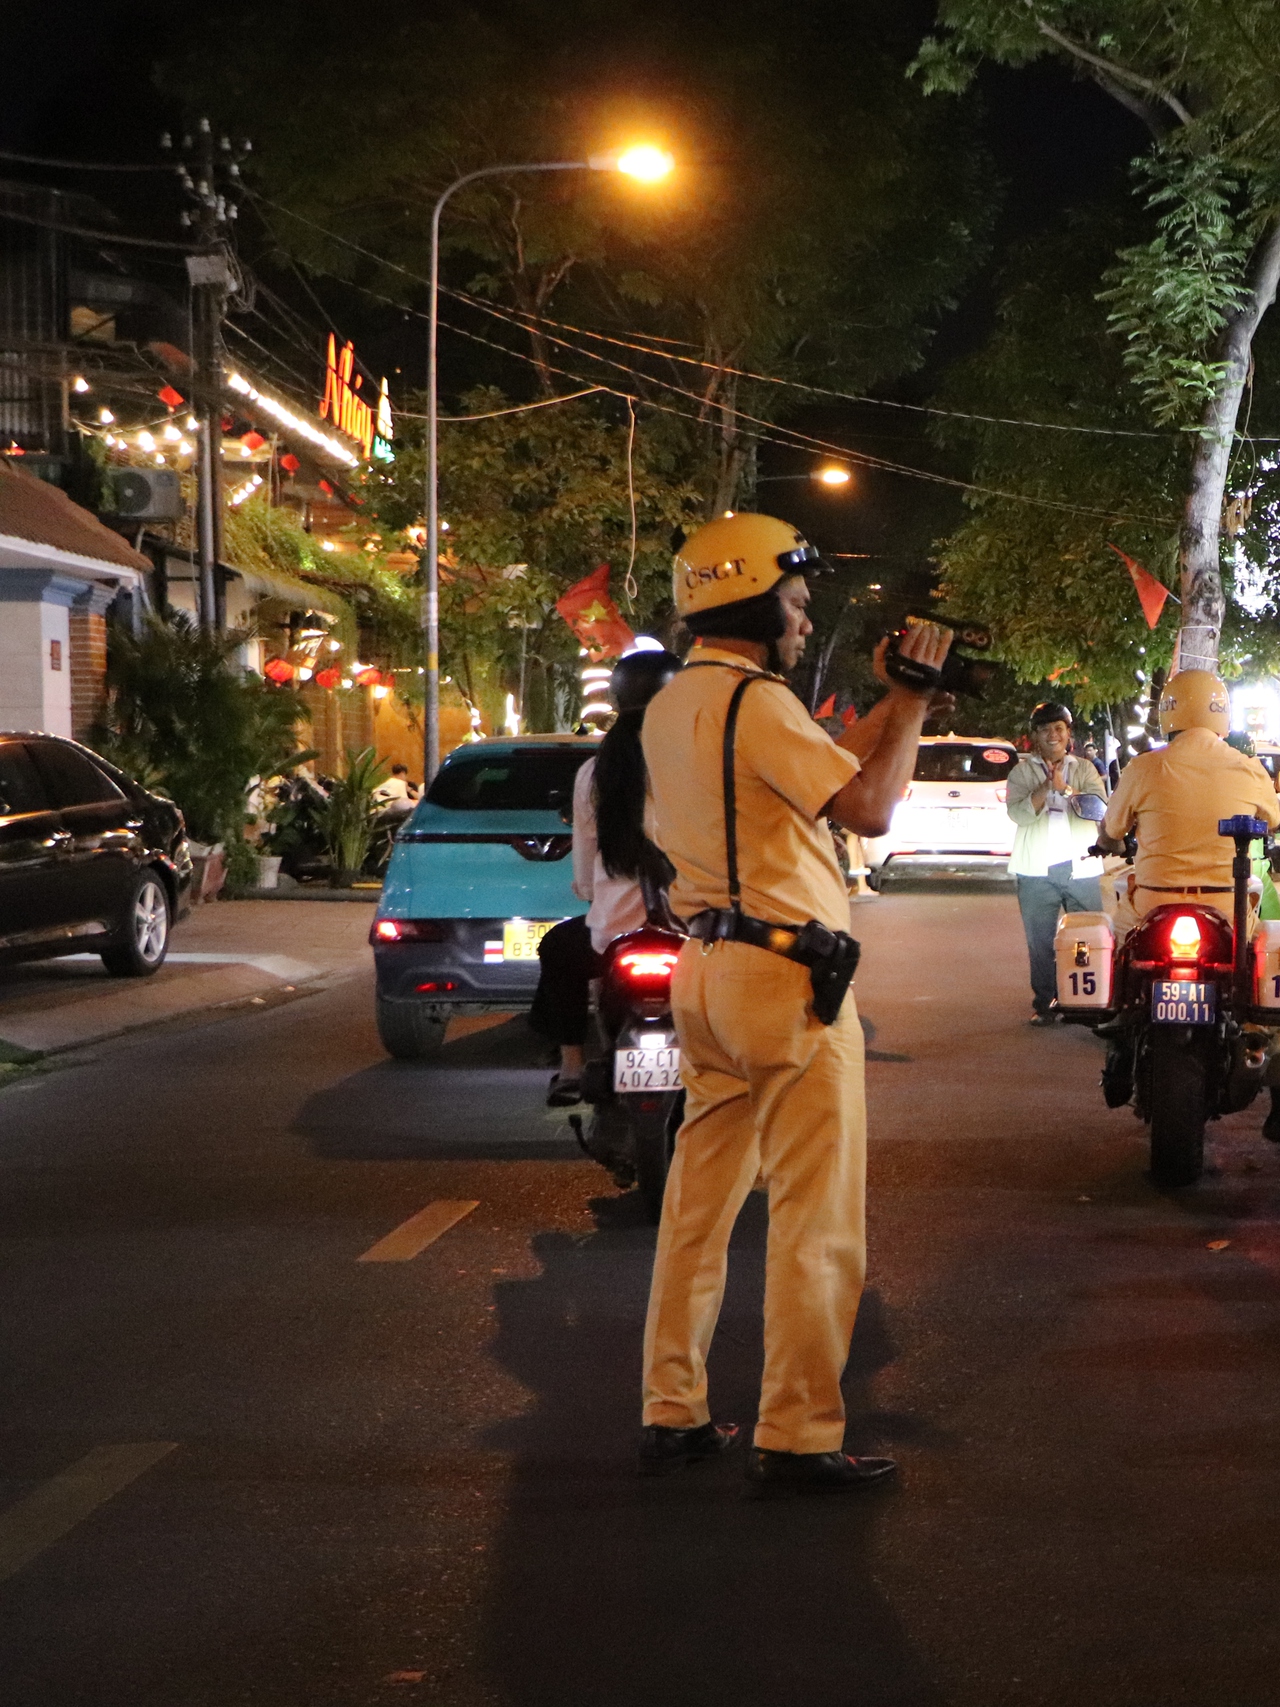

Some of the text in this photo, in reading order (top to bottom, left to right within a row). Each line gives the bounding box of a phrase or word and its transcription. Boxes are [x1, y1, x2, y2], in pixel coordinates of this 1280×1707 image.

[685, 557, 746, 590] CSGT
[1069, 972, 1097, 996] 15
[1162, 982, 1206, 1002] 59-A1
[1157, 1003, 1210, 1022] 000.11
[626, 1051, 676, 1068] 92-C1
